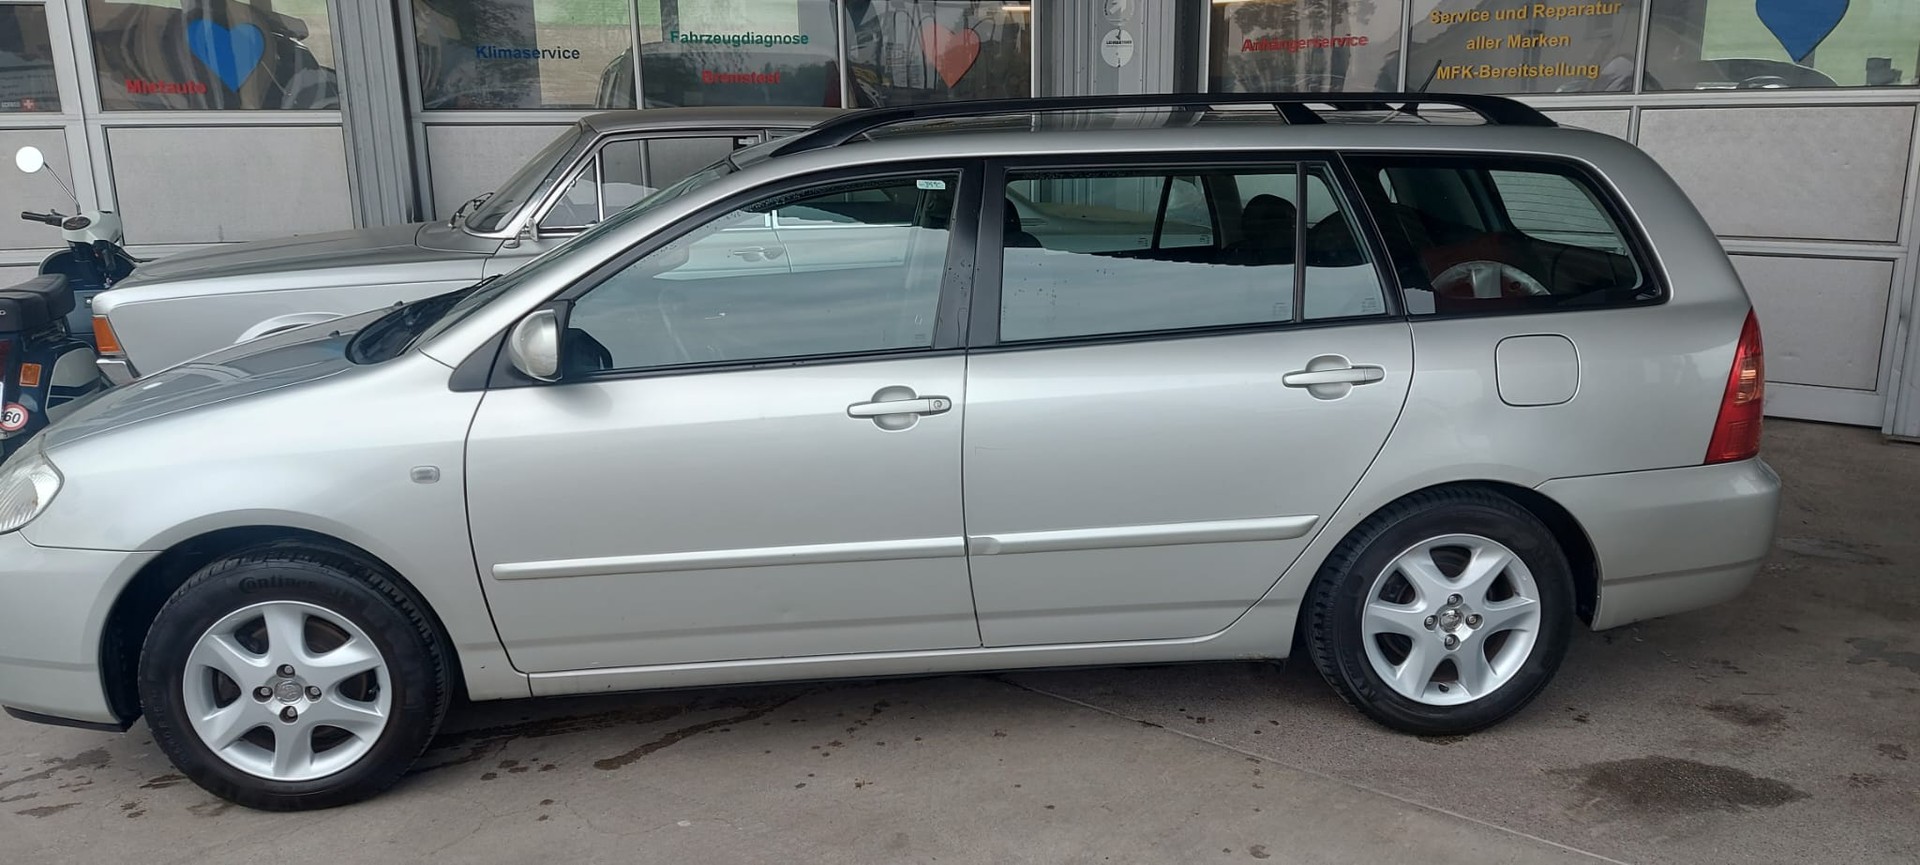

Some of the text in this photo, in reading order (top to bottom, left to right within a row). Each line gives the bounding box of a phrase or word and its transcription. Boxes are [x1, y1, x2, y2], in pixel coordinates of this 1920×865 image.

[1430, 1, 1623, 25] Service und Reparatur
[670, 30, 809, 48] Fahrzeugdiagnose
[1466, 33, 1572, 51] aller Marken
[475, 45, 581, 60] Klimaservice
[1435, 60, 1601, 81] MFK-Bereitstellung
[125, 79, 208, 95] Mietauto
[4, 411, 21, 424] 60
